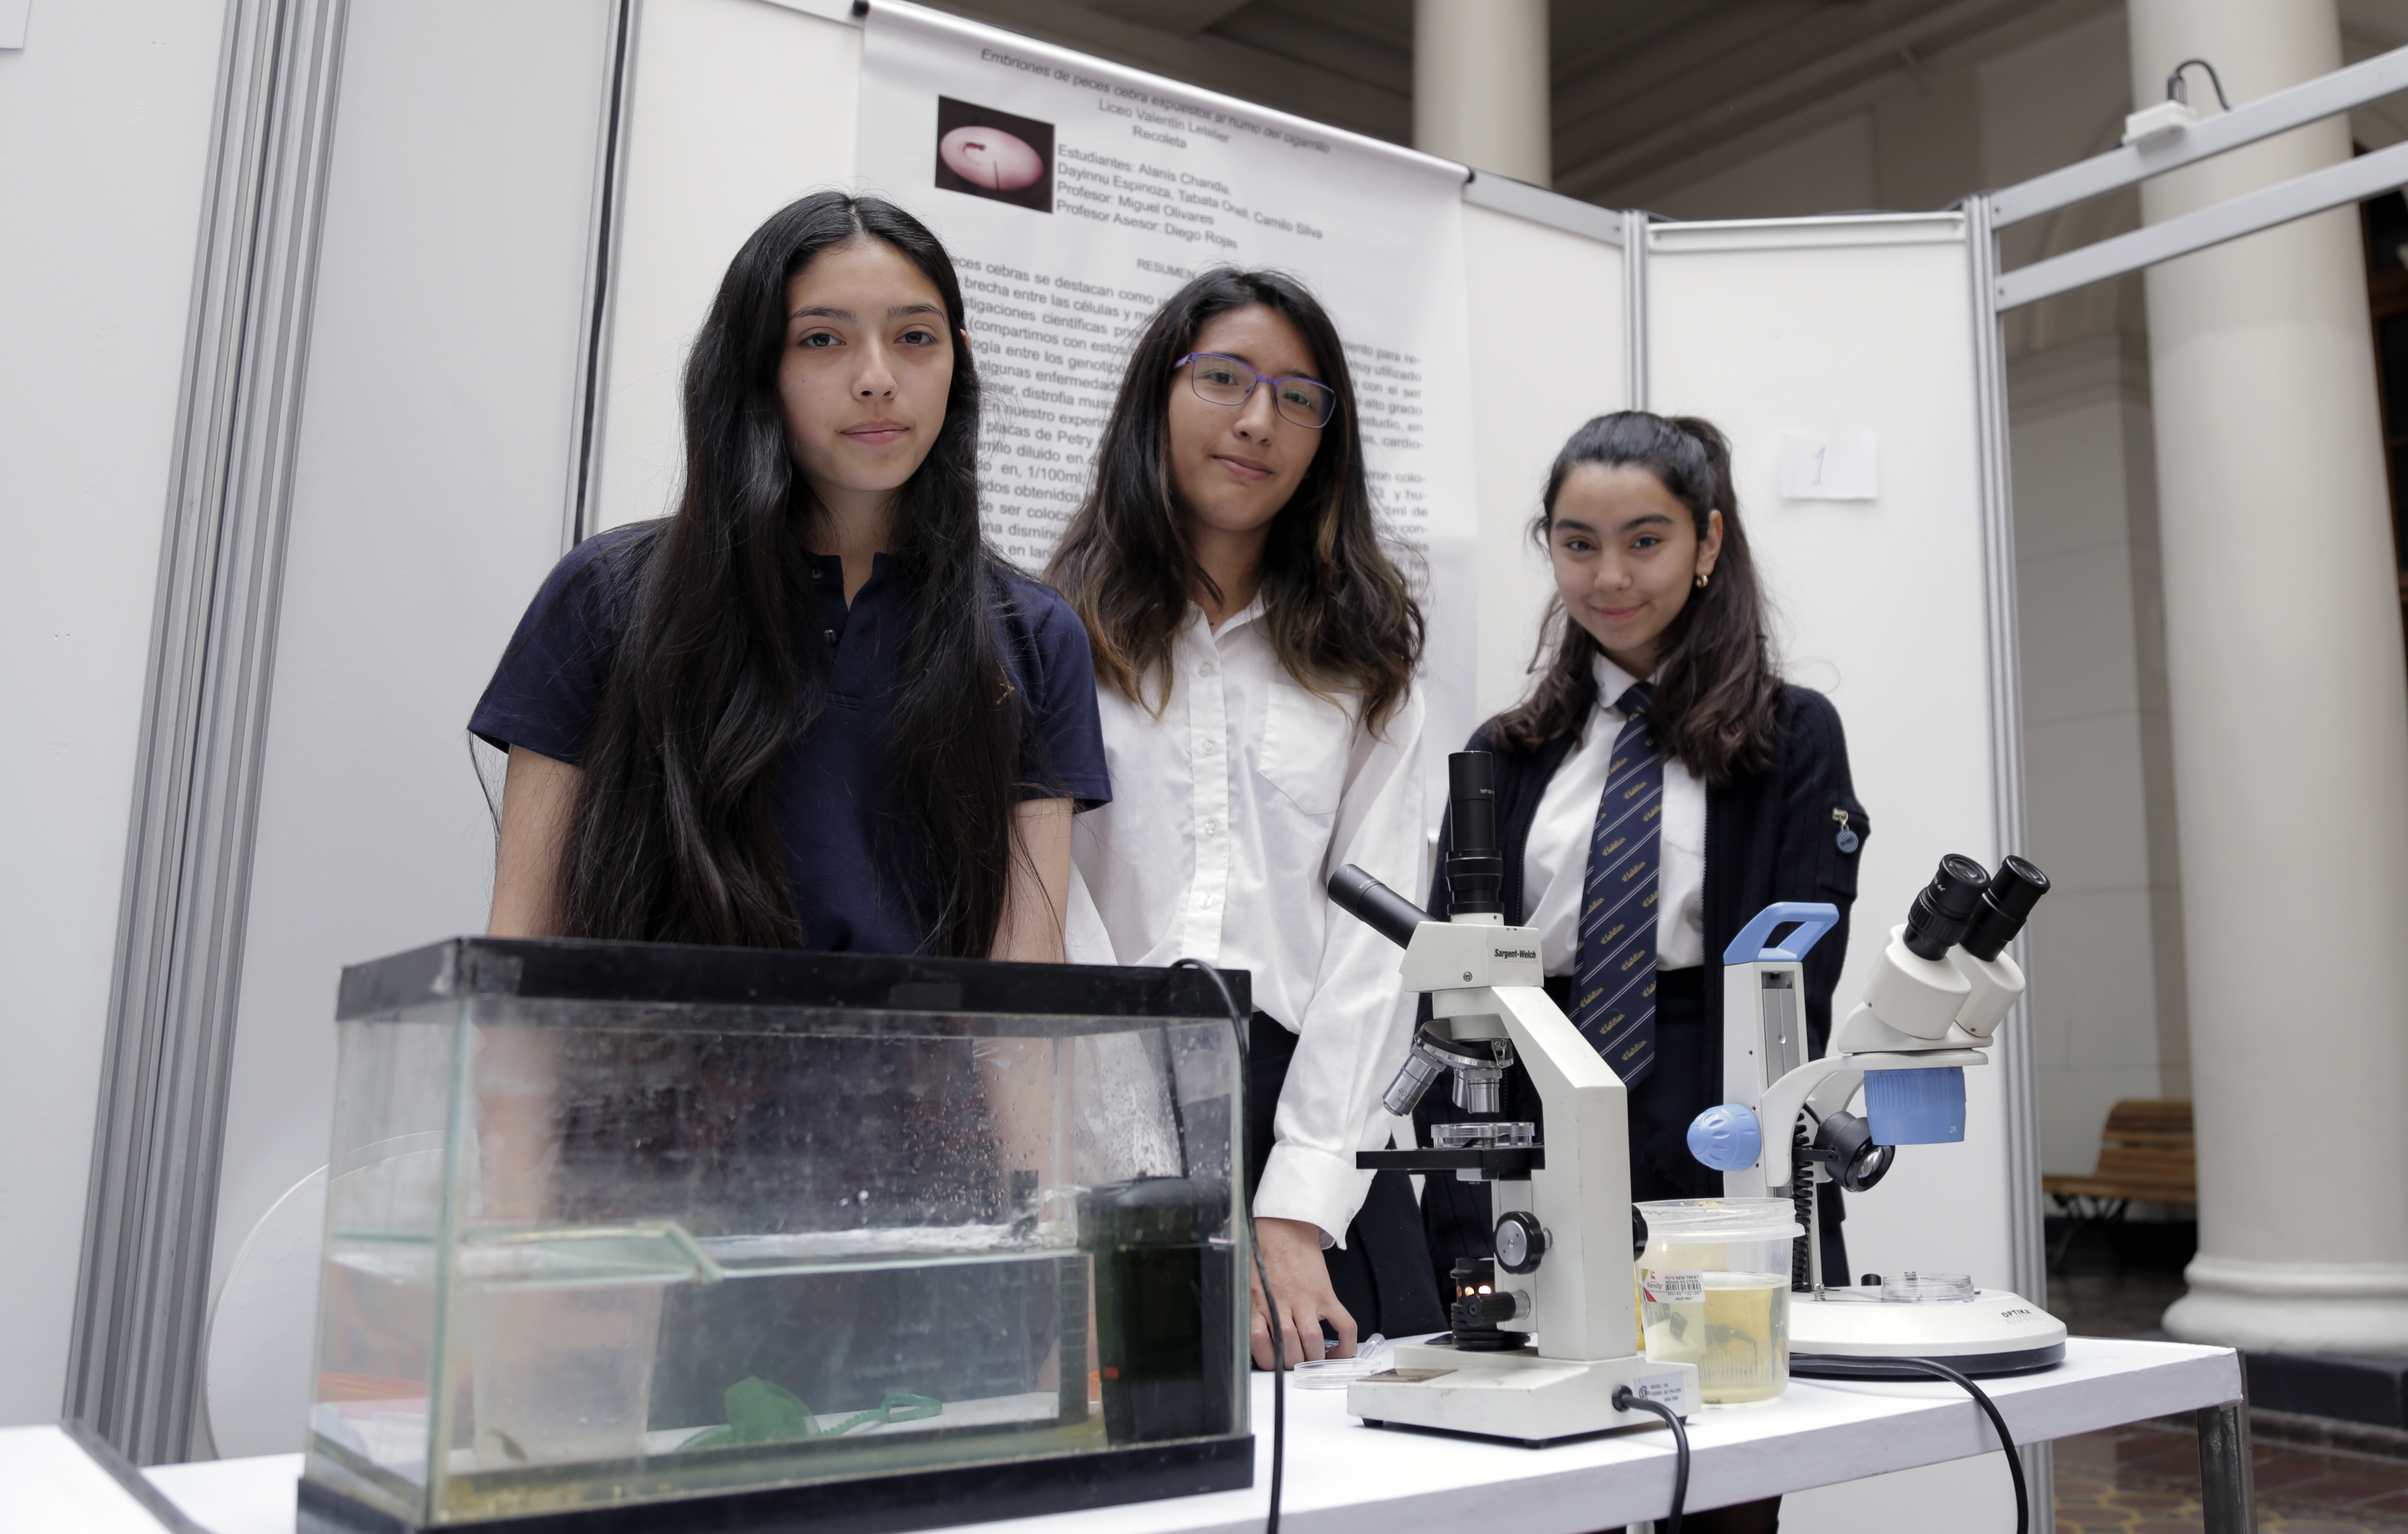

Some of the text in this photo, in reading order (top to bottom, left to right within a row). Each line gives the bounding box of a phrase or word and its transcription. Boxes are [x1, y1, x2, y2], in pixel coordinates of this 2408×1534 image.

[981, 48, 1051, 77] Embriones
[1054, 68, 1070, 81] de
[1073, 75, 1110, 94] peces
[1114, 86, 1148, 103] cebra
[1099, 98, 1133, 118] Liceo
[1133, 125, 1187, 149] Recoleta
[1058, 143, 1135, 172] Estudiantes:
[1138, 163, 1177, 182] Alanis
[1056, 199, 1111, 222] Profesor
[1164, 222, 1201, 242] Diego
[1205, 231, 1238, 249] Rojas
[1118, 194, 1160, 213] Miguel
[1164, 204, 1215, 226] Olivares
[1178, 188, 1219, 208] Tabata
[1254, 211, 1293, 232] Camilo
[1295, 221, 1323, 240] Silva
[986, 263, 1030, 282] cebras
[1035, 273, 1051, 286] se
[1055, 276, 1114, 297] destacan
[1118, 289, 1155, 305] como
[1137, 258, 1196, 279] RESUMEN
[965, 274, 1010, 297] brecha
[1013, 289, 1048, 304] entre
[1051, 293, 1070, 309] las
[1124, 309, 1132, 322] y
[1006, 346, 1040, 361] entre
[1044, 350, 1064, 365] los
[1408, 422, 1423, 433] en
[1063, 336, 1087, 350] con
[1091, 341, 1126, 356] estos
[1365, 398, 1385, 411] alto
[1389, 401, 1423, 415] grado
[1363, 380, 1383, 393] con
[1036, 427, 1052, 442] de
[1057, 429, 1094, 449] Petry
[1017, 444, 1061, 462] diluido
[1066, 453, 1084, 465] en
[1413, 507, 1429, 517] de
[1000, 503, 1021, 516] ser
[1009, 545, 1025, 557] en
[1494, 948, 1536, 959] Sargent-Welch
[2001, 1308, 2032, 1317] OPTIKA
